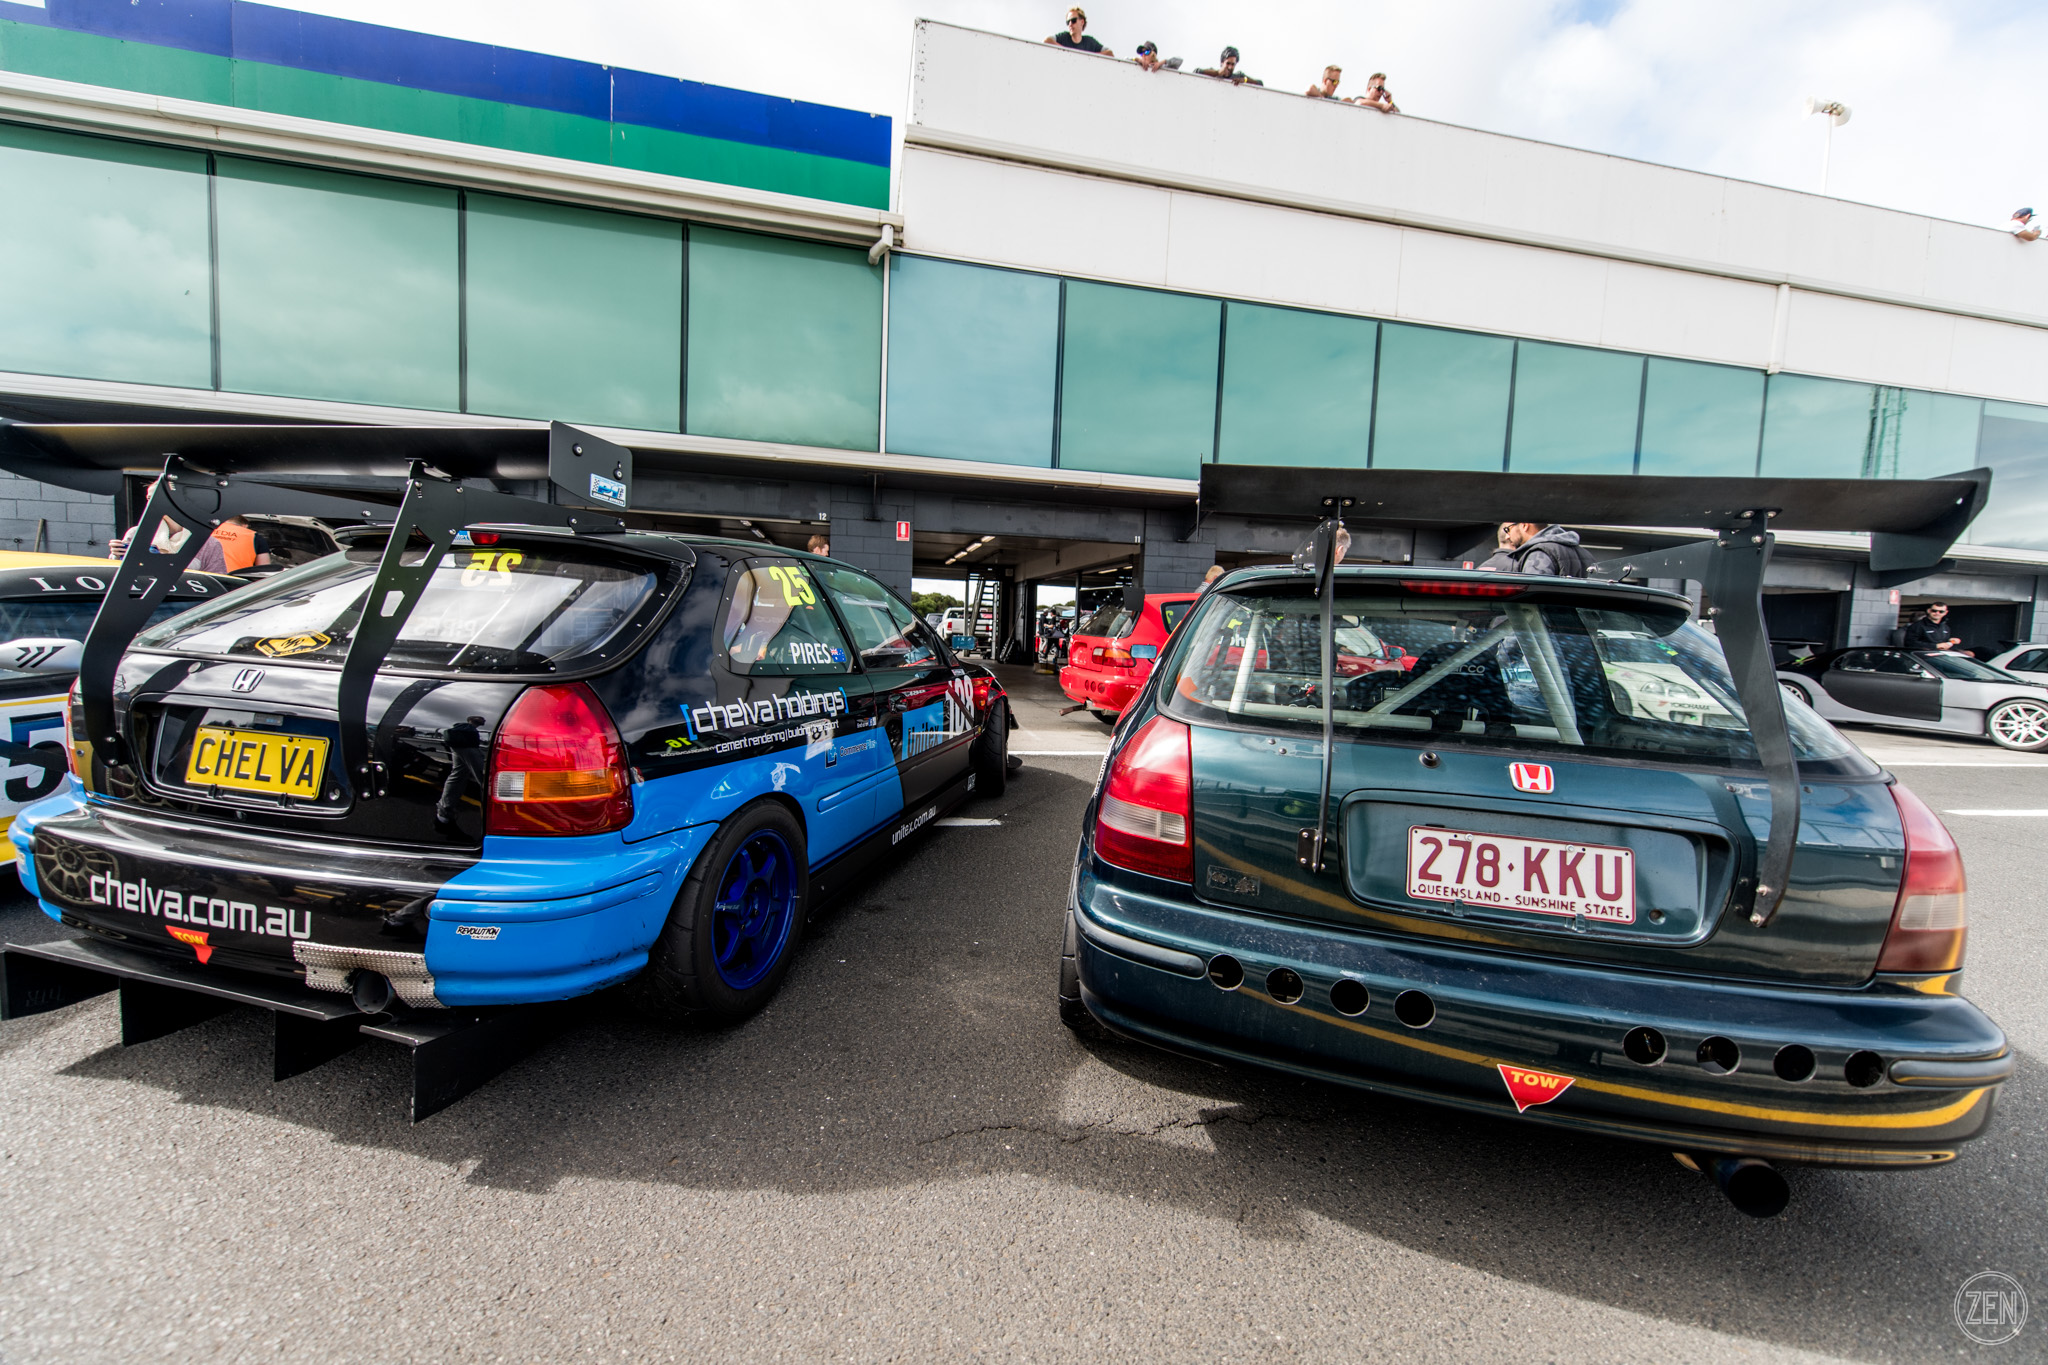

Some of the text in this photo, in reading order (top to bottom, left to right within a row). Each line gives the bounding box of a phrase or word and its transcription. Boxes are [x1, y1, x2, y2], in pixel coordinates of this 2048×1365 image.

[818, 512, 827, 521] 12
[214, 529, 238, 538] EDIA
[29, 577, 208, 593] LOS
[768, 566, 816, 607] 25
[790, 642, 832, 664] PIRES
[1670, 702, 1710, 710] YOKOHAMA
[715, 737, 748, 754] cement
[195, 738, 316, 787] CHELVA
[891, 805, 937, 845] unitex.com.au
[90, 870, 312, 940] chelva.com.au
[1418, 883, 1501, 903] QUEENSLAND
[1515, 895, 1576, 912] SUNSHINE
[1585, 903, 1624, 918] STATE
[174, 931, 205, 946] TOW
[457, 926, 500, 936] REVOLUTION
[1510, 1070, 1560, 1090] TOW
